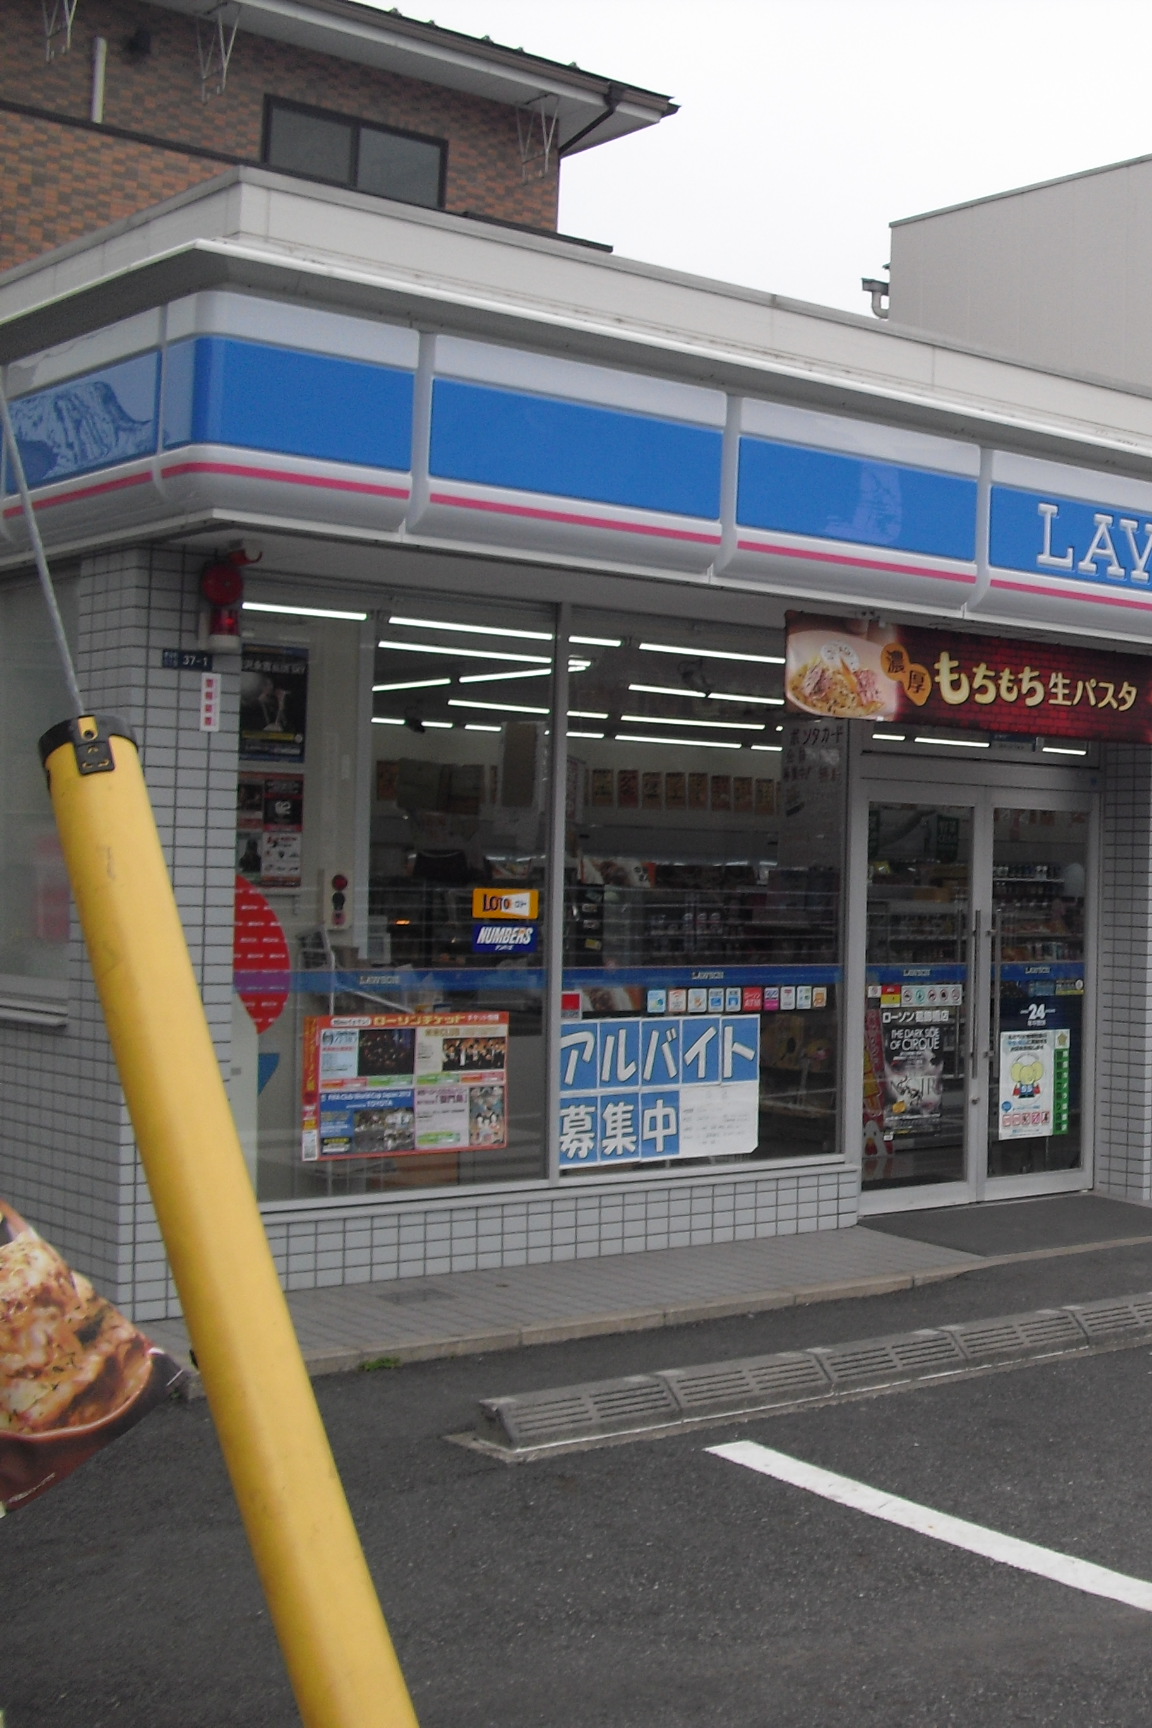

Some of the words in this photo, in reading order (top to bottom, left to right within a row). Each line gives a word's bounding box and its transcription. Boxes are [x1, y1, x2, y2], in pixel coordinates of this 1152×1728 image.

[885, 649, 928, 694] 濃厚
[483, 894, 510, 912] LOTO
[477, 926, 534, 945] NUMBERS
[1028, 1003, 1046, 1020] 24
[891, 1029, 904, 1039] THE
[904, 1028, 924, 1039] DARK
[924, 1027, 940, 1039] SIDE
[890, 1040, 902, 1050] OF
[902, 1038, 940, 1050] CIRQUE
[561, 1026, 755, 1085] アルバイト
[560, 1099, 677, 1160] 募集中
